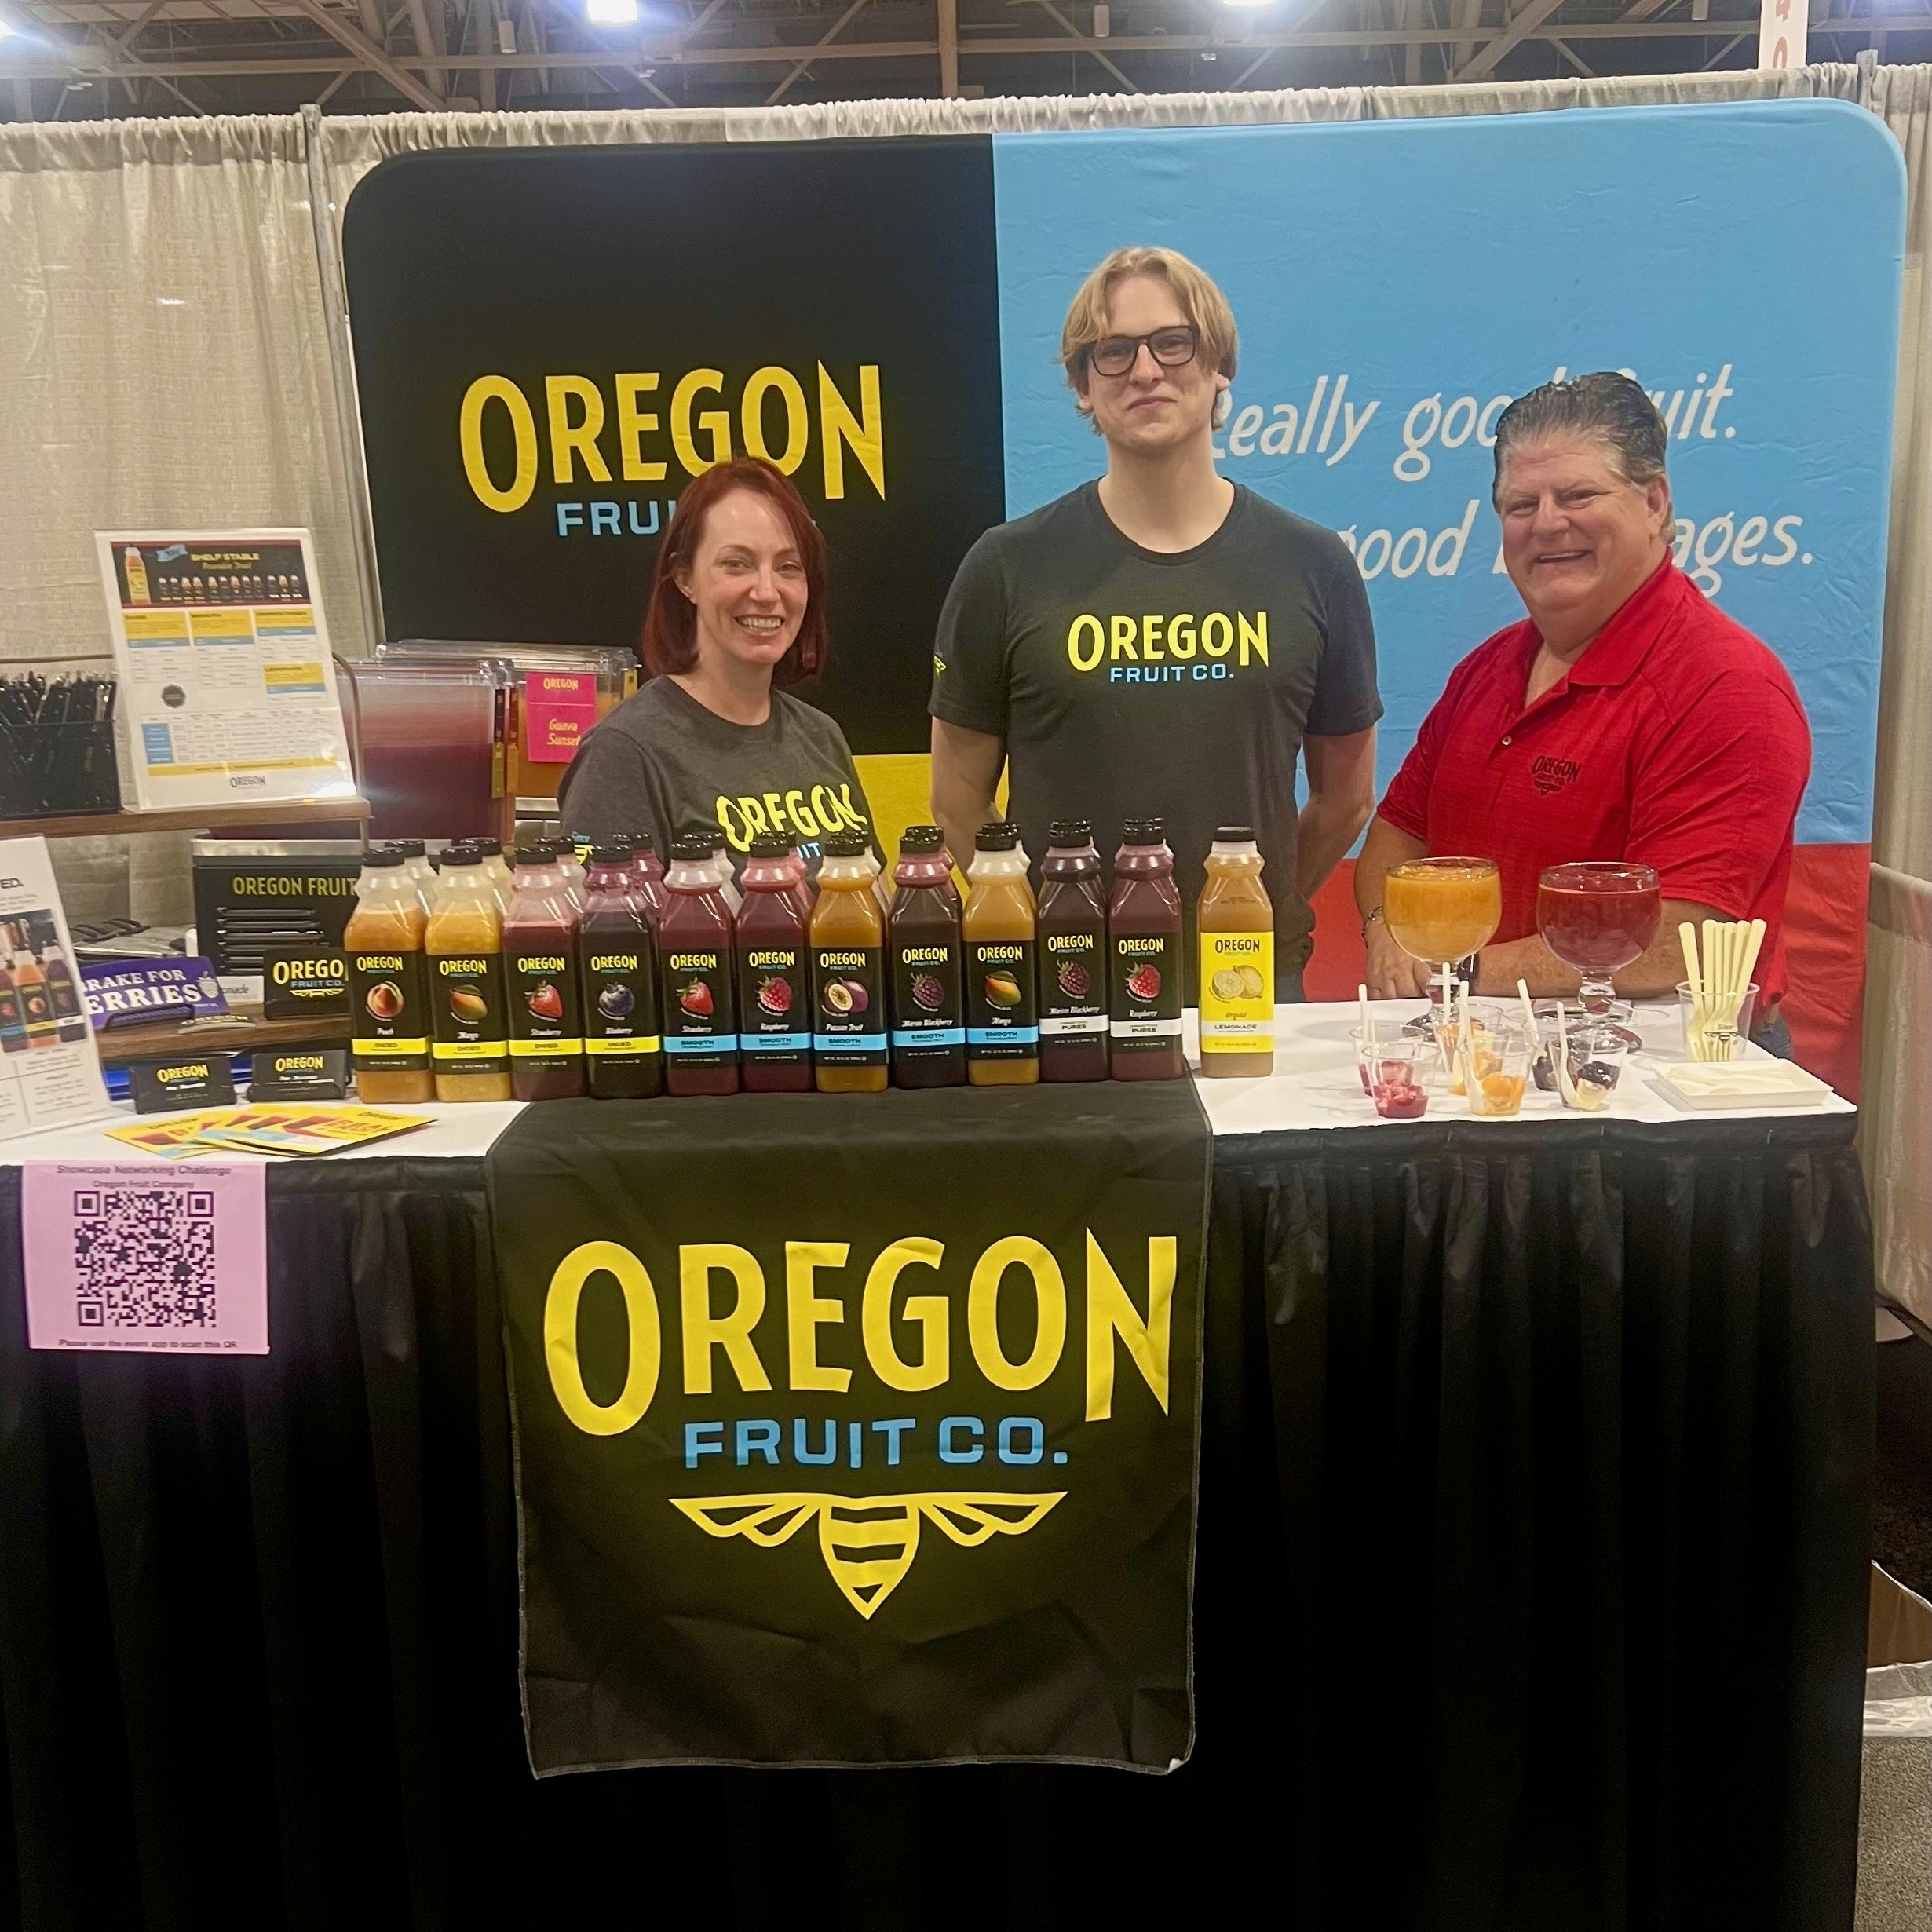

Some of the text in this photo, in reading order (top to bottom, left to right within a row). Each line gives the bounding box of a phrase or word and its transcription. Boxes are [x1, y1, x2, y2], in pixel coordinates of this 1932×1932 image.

[1393, 367, 1565, 482] goo
[459, 359, 886, 513] OREGON
[1068, 610, 1269, 672] OREGON
[1110, 663, 1235, 683] FRUIT CO.
[543, 677, 579, 690] OREGON
[549, 718, 579, 731] Guava
[1532, 755, 1583, 782] OREGON
[716, 783, 868, 852] OREGON
[232, 876, 357, 896] OREGON FRUIT
[1048, 934, 1094, 951] OREGON
[1118, 937, 1164, 955] OREGON
[1215, 939, 1260, 954] OREGON
[749, 951, 795, 967] OREGON
[820, 952, 866, 968] OREGON
[902, 948, 948, 963] OREGON
[977, 946, 1023, 961] OREGON
[356, 956, 403, 971] OREGON
[439, 959, 487, 975] OREGON
[517, 957, 565, 973] OREGON
[591, 955, 637, 971] OREGON
[670, 954, 717, 970] OREGON
[147, 970, 187, 983] FOR
[85, 984, 202, 1015] ERRIES
[275, 1056, 323, 1072] OREGON
[156, 1065, 209, 1083] OREGON
[57, 1165, 231, 1176] Showcase Networking Challenge
[93, 1180, 126, 1189] Oregon
[544, 1227, 1178, 1436] OREGON
[685, 1415, 1069, 1470] FRUIT CO.
